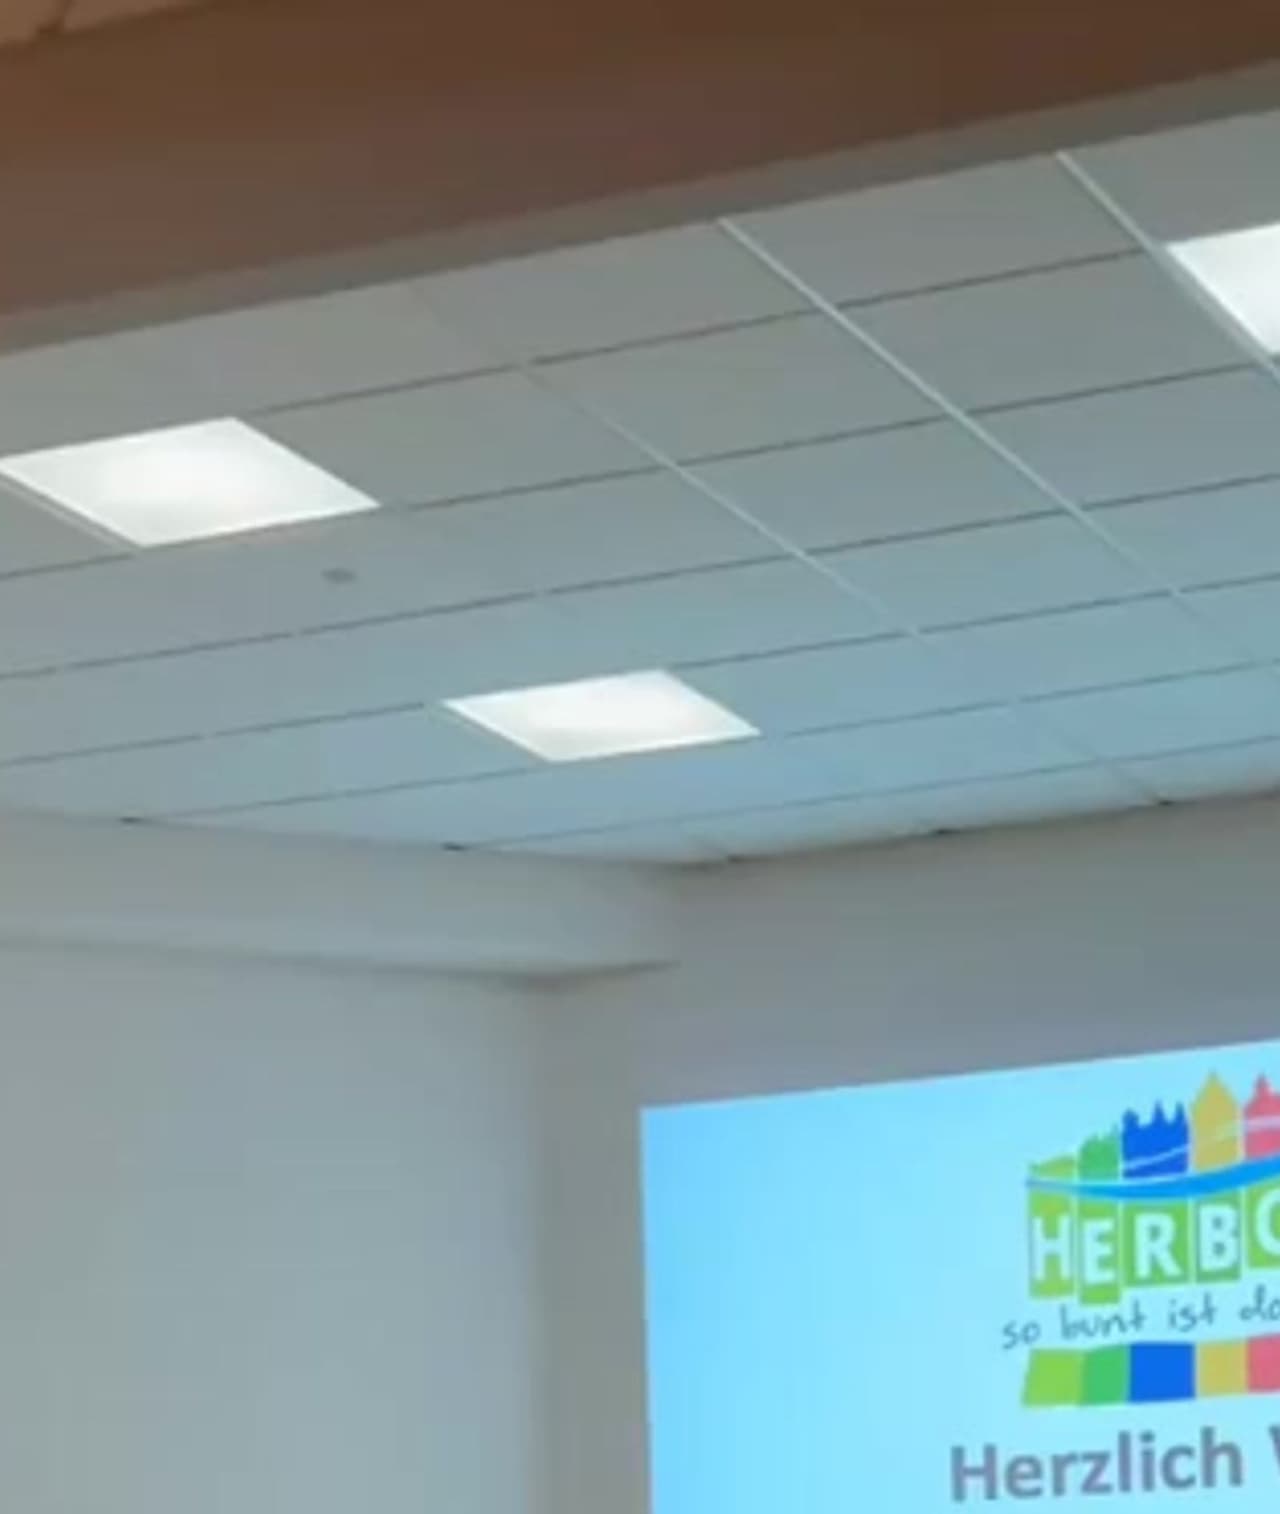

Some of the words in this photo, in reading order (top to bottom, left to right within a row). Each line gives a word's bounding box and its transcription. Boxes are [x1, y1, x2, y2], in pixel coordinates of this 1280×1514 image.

[1001, 1321, 1041, 1350] so
[1060, 1301, 1145, 1342] bunt
[1167, 1292, 1218, 1331] ist
[950, 1425, 1245, 1502] Herzlich
